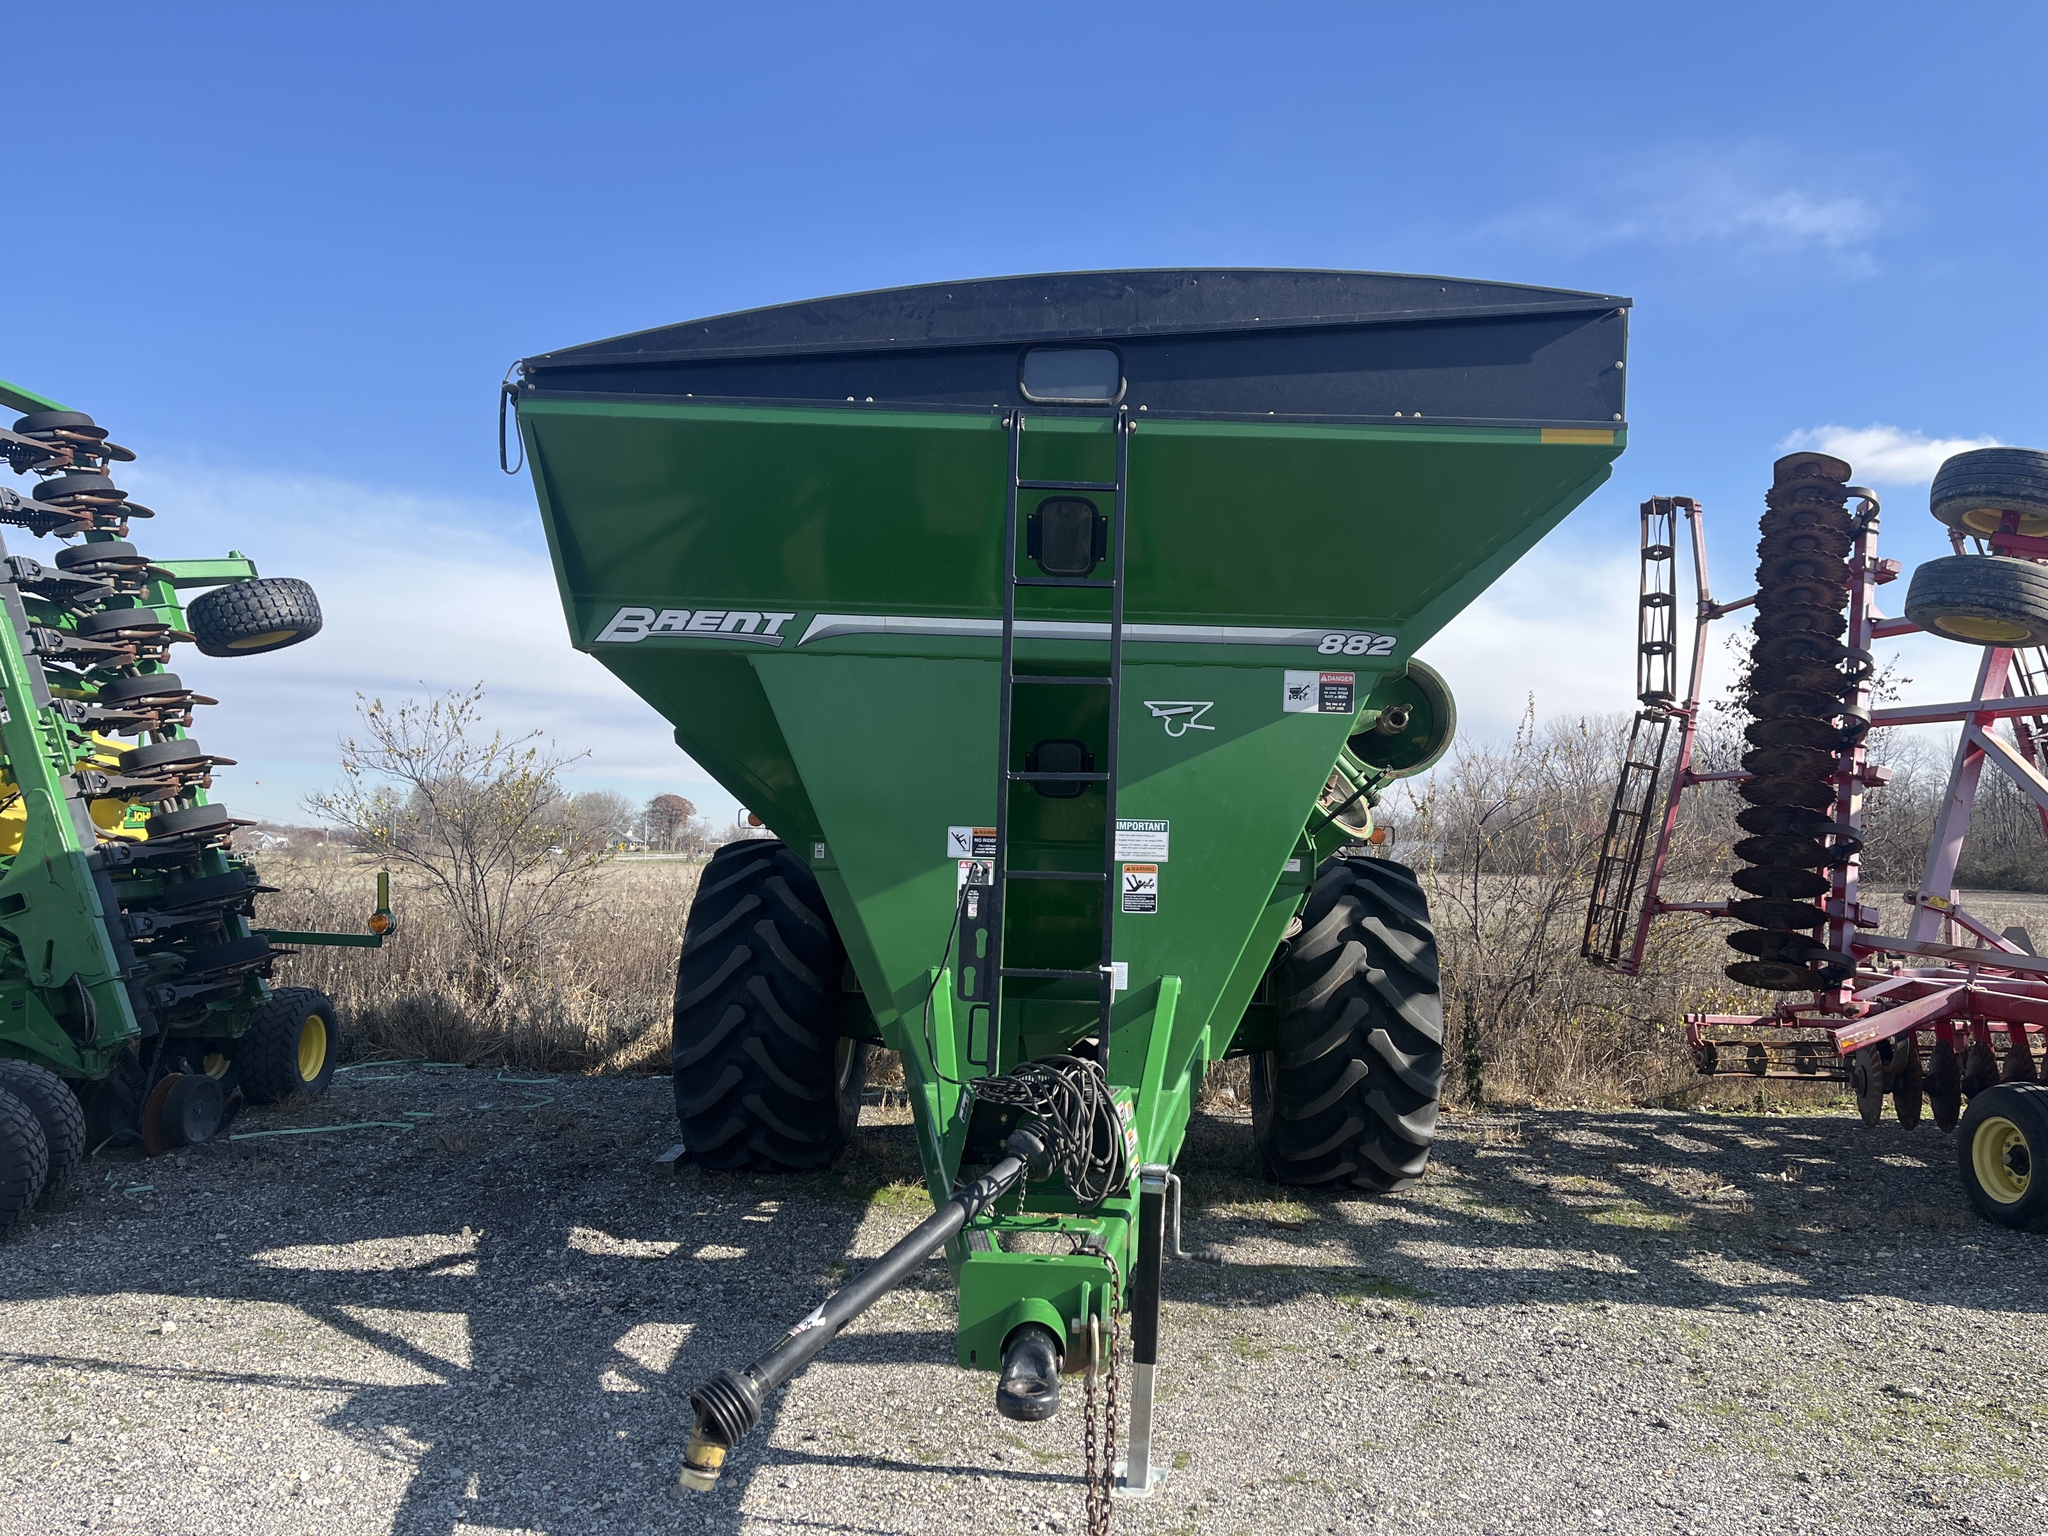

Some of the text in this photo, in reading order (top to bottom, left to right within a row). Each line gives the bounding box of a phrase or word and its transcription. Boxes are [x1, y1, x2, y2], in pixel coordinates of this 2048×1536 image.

[594, 607, 796, 643] BRENT
[1317, 634, 1398, 656] 882
[1116, 821, 1166, 831] IMPORTANT
